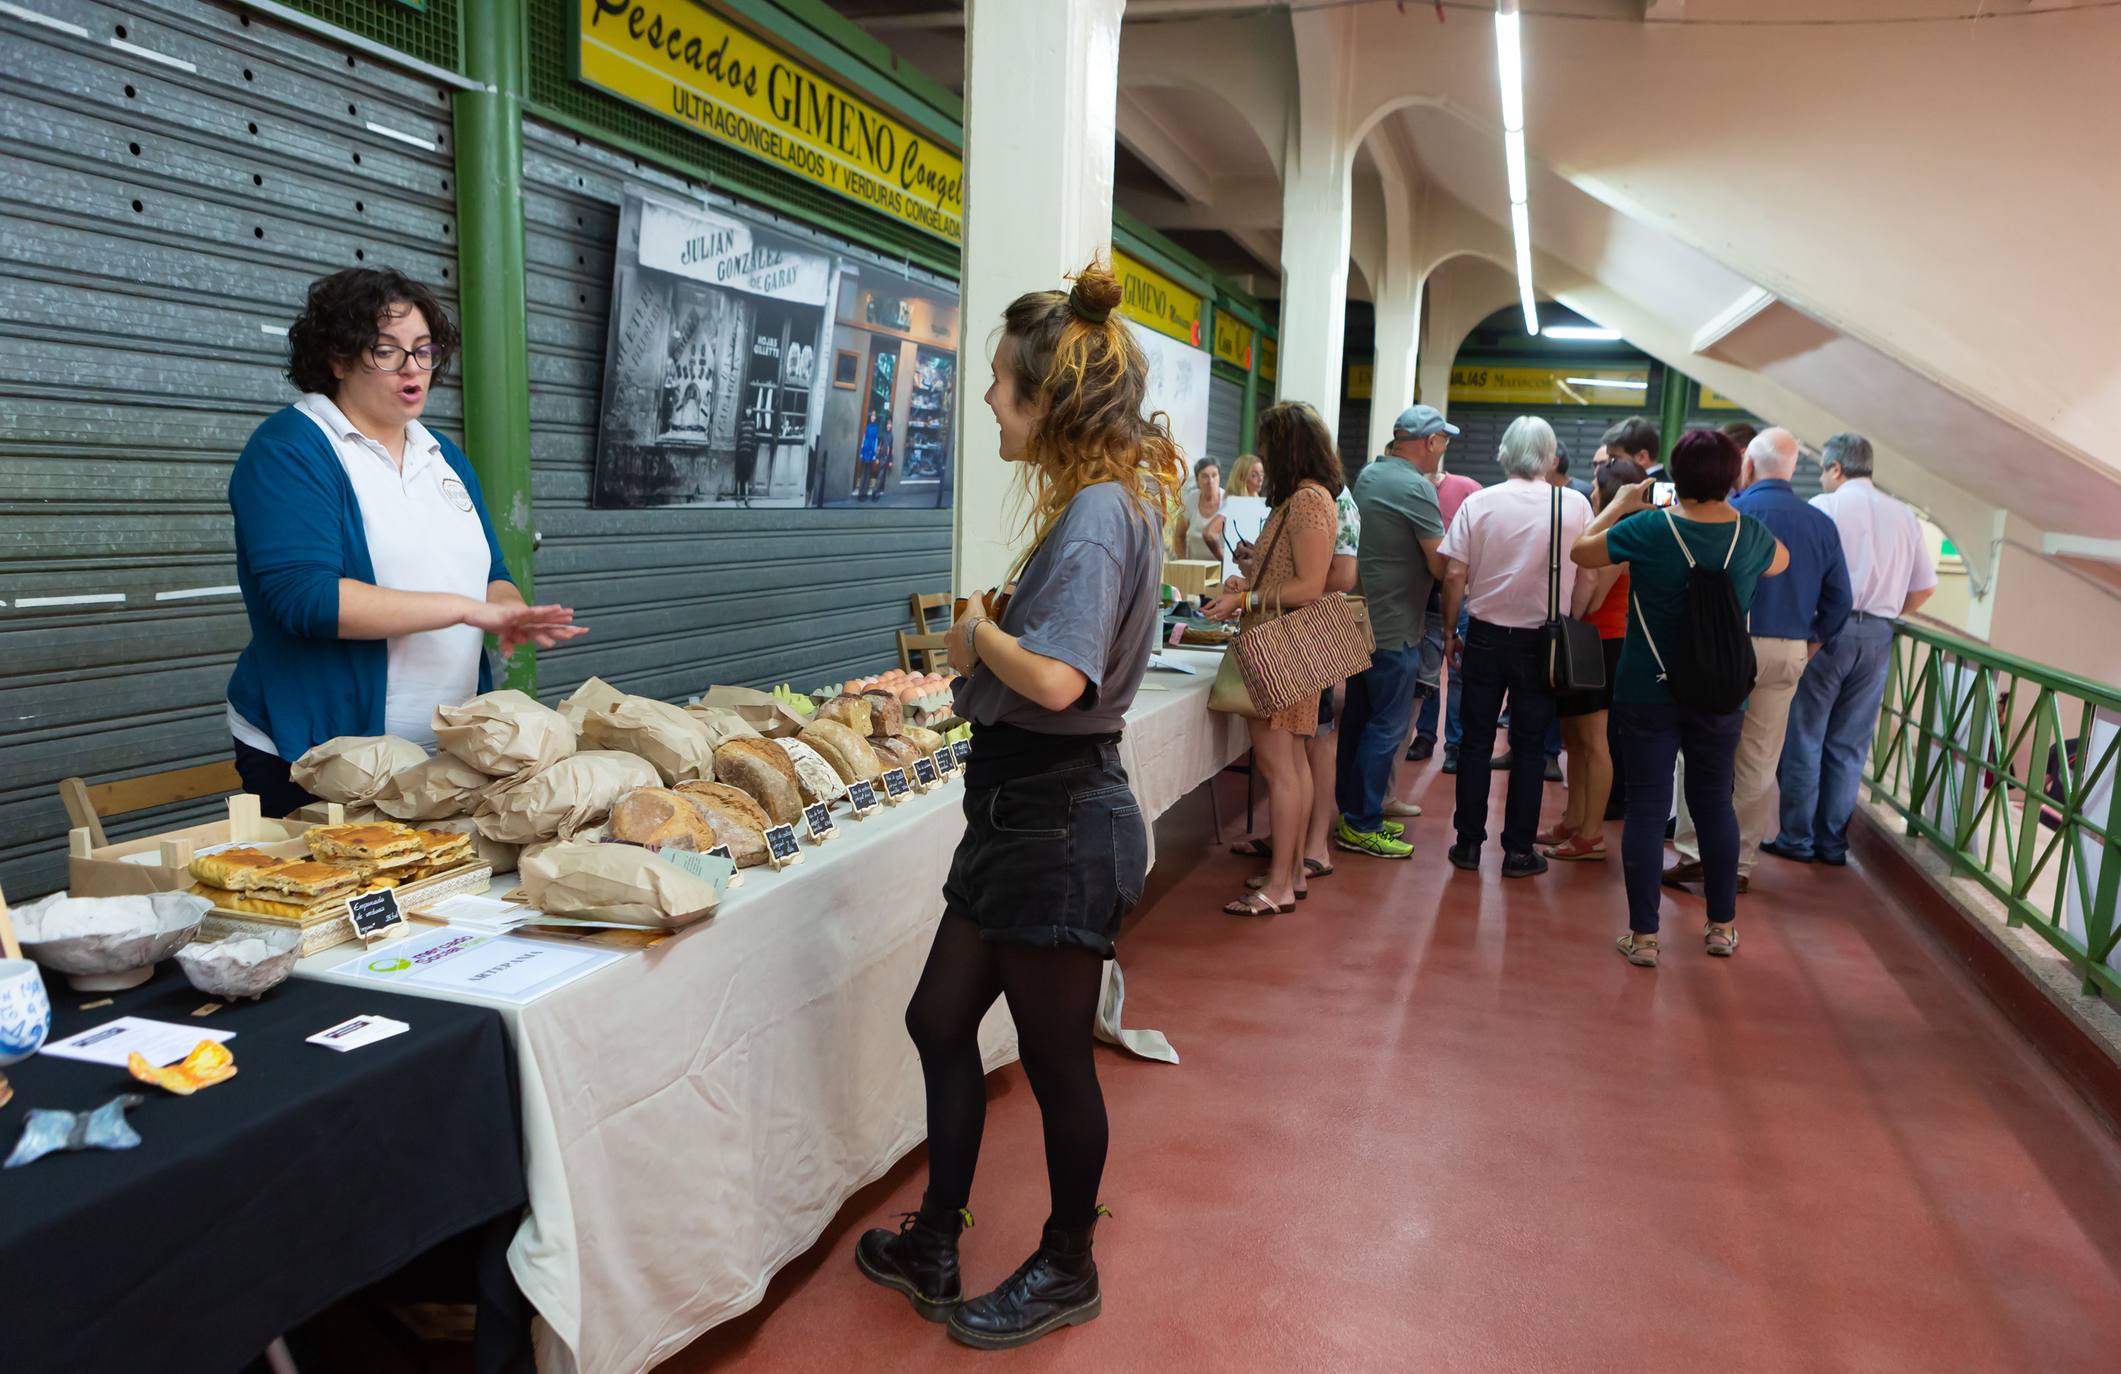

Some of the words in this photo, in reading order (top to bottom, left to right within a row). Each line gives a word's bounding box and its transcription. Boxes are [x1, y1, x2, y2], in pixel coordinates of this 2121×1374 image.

[767, 62, 896, 174] GIMENO
[830, 159, 838, 184] Y
[843, 167, 902, 213] VERDURAS
[681, 228, 735, 266] JULIAN
[717, 248, 784, 282] GONZALEZ
[764, 264, 800, 293] GARAY
[1124, 272, 1167, 319] GIMENO
